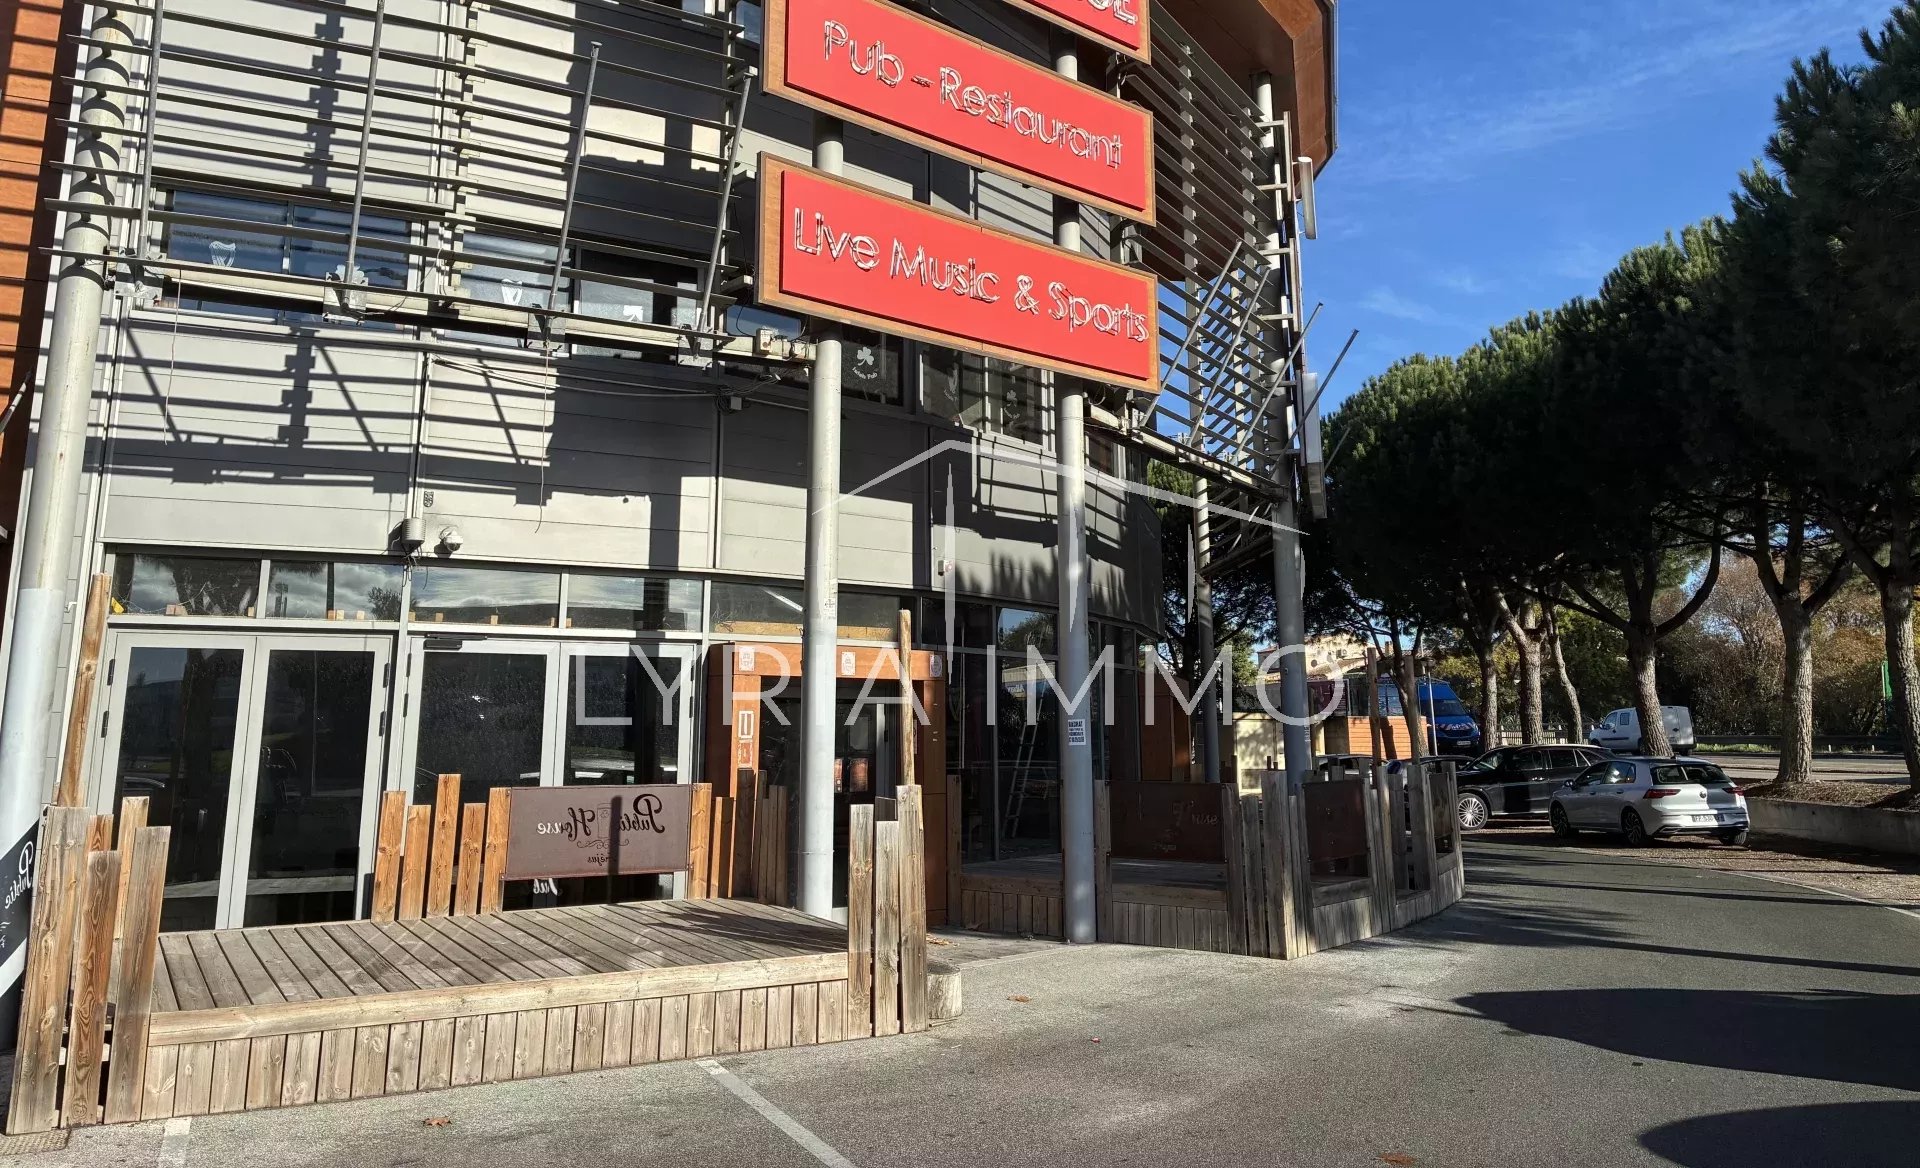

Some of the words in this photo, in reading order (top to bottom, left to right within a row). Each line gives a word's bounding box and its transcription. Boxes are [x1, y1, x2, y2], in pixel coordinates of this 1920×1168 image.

[824, 20, 905, 86] Pub
[939, 66, 1123, 169] Restaurant
[794, 207, 881, 271] Live
[890, 238, 1000, 304] Music
[1015, 274, 1041, 315] &
[1047, 281, 1149, 343] Sports
